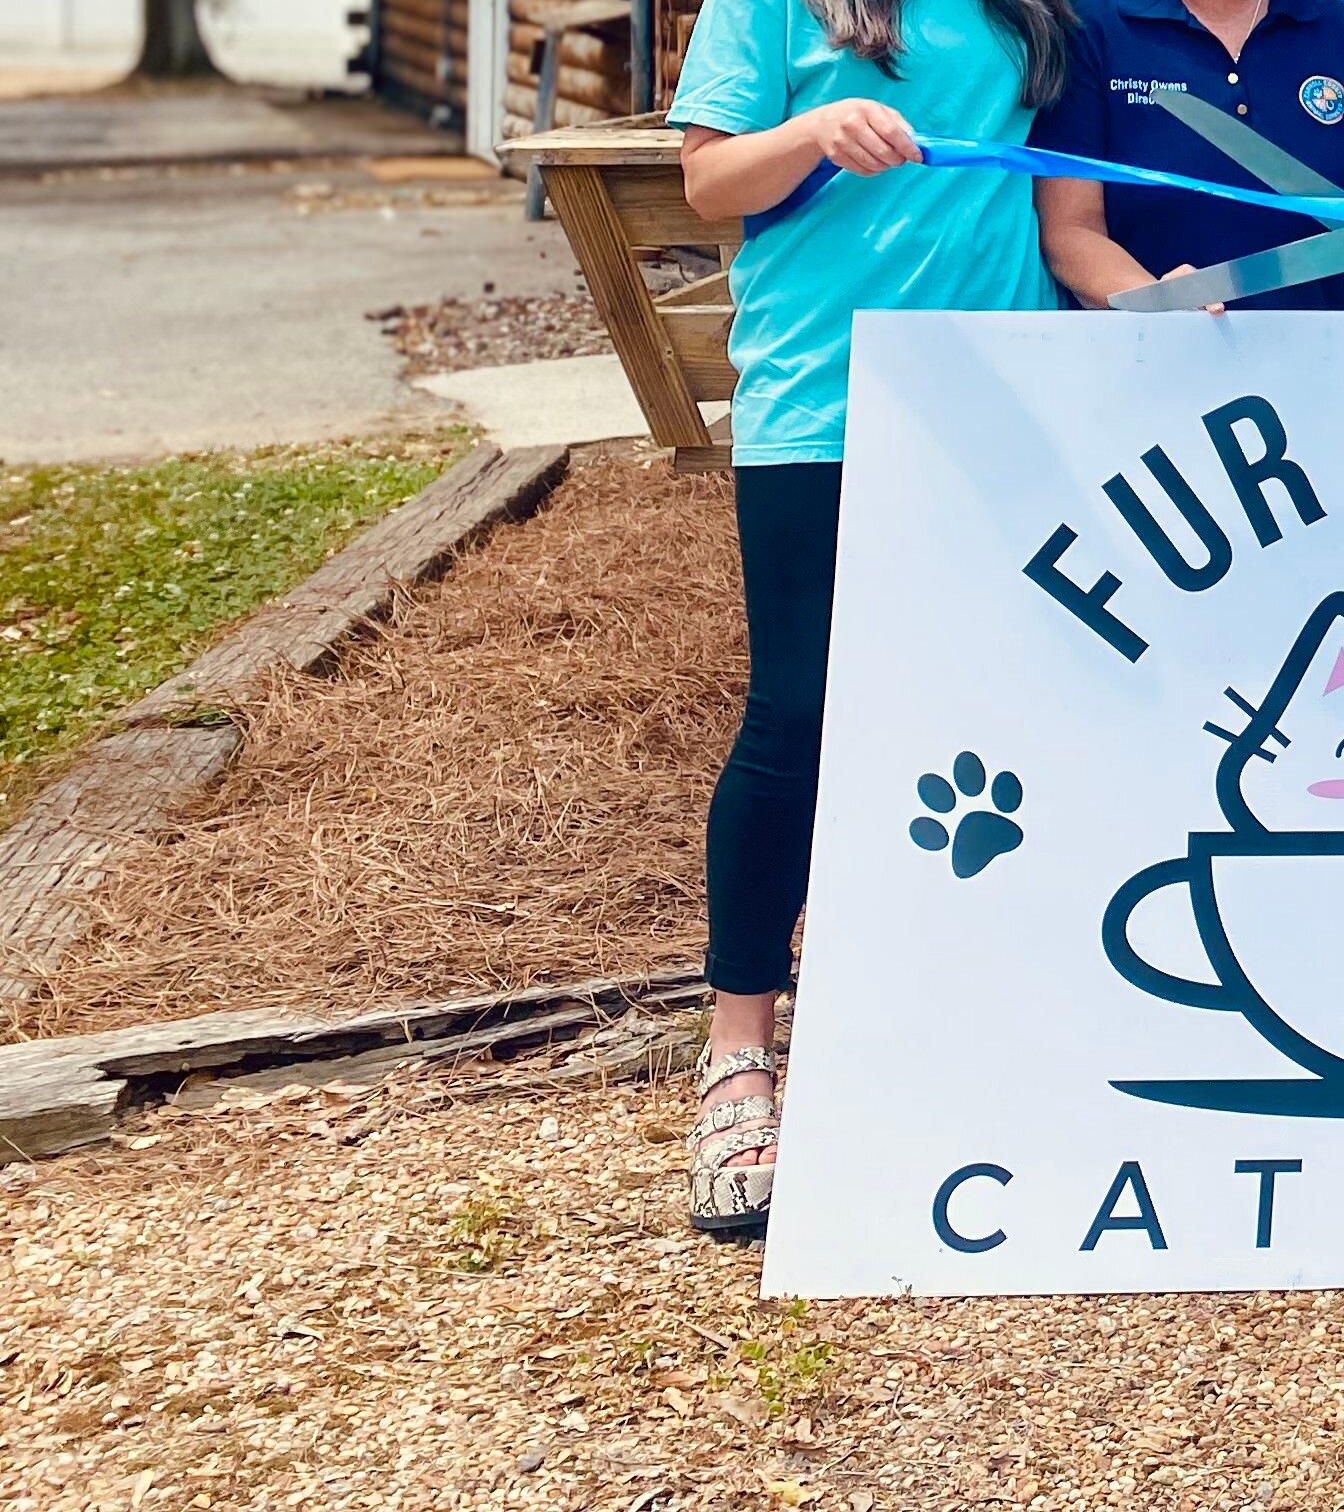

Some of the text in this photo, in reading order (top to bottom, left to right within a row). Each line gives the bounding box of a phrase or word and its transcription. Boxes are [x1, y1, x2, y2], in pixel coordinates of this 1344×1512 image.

[1110, 78, 1187, 92] Christy Owens
[1127, 92, 1158, 105] Direc
[1022, 396, 1327, 663] FUR
[932, 1159, 1302, 1254] CAT
